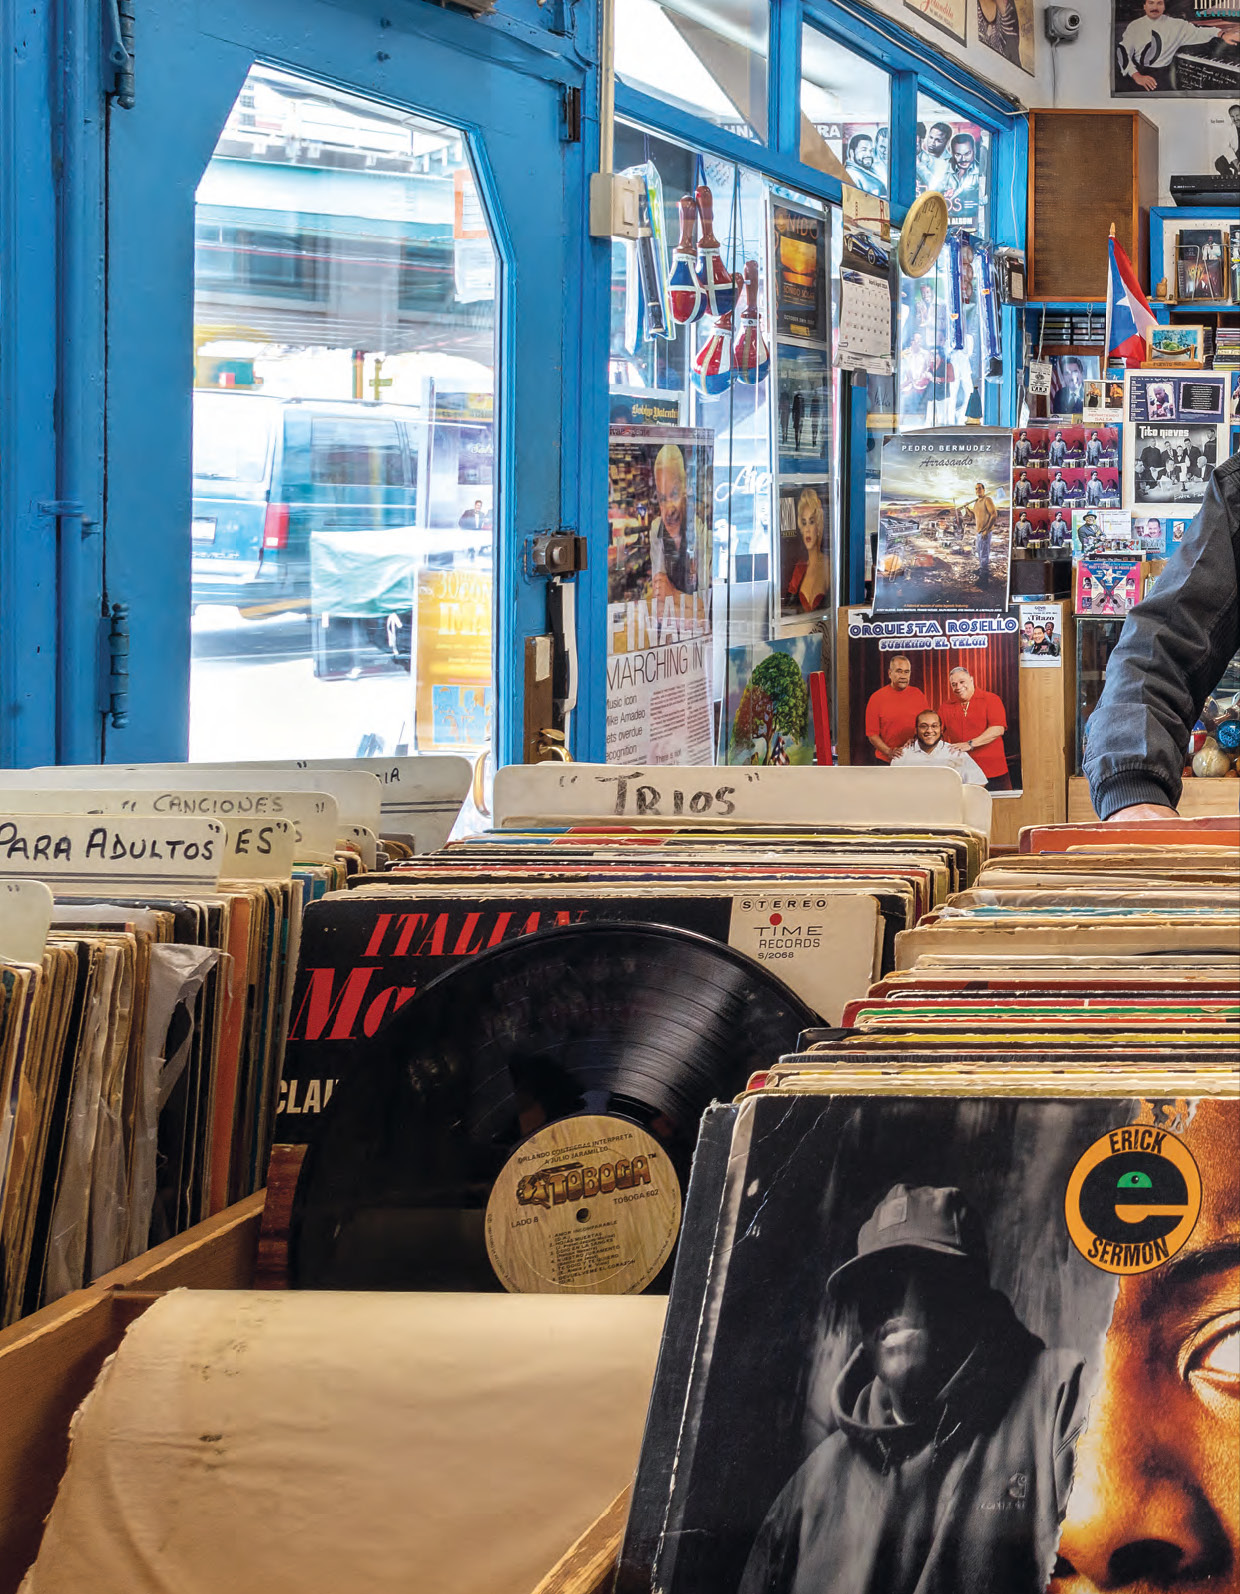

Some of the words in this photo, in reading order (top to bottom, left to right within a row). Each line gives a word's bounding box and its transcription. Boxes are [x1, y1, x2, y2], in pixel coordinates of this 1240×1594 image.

[1139, 426, 1158, 439] Tito
[1159, 428, 1189, 438] nieves
[919, 455, 973, 468] Arrasando
[607, 588, 713, 656] FINALLY
[848, 621, 942, 638] ORQUESTA
[880, 637, 932, 650] SUBIENDO
[934, 637, 949, 649] EL
[606, 645, 688, 691] MARCHING
[692, 643, 703, 671] IN
[606, 696, 624, 710] usic
[624, 693, 637, 706] icon
[606, 713, 619, 727] ike
[620, 708, 645, 724] Amadeo
[605, 732, 617, 745] ets
[618, 726, 643, 742] overdue
[605, 744, 637, 761] ecognition
[375, 767, 401, 783] IA
[153, 793, 285, 814] CANCIONES
[225, 821, 289, 855] ES"
[740, 898, 829, 911] STEREO
[753, 925, 824, 938] TIME
[759, 938, 821, 949] RECORDS
[757, 951, 795, 960] S/2068
[518, 1151, 550, 1164] ORLANDO
[592, 1133, 633, 1147] INTERPRETA
[1108, 1129, 1168, 1155] ERICK
[550, 1155, 569, 1164] JULIO
[549, 1155, 652, 1206] TOBOGA
[613, 1192, 645, 1206] TOBOGA
[511, 1218, 533, 1229] LADO
[1087, 1236, 1170, 1267] SERMON
